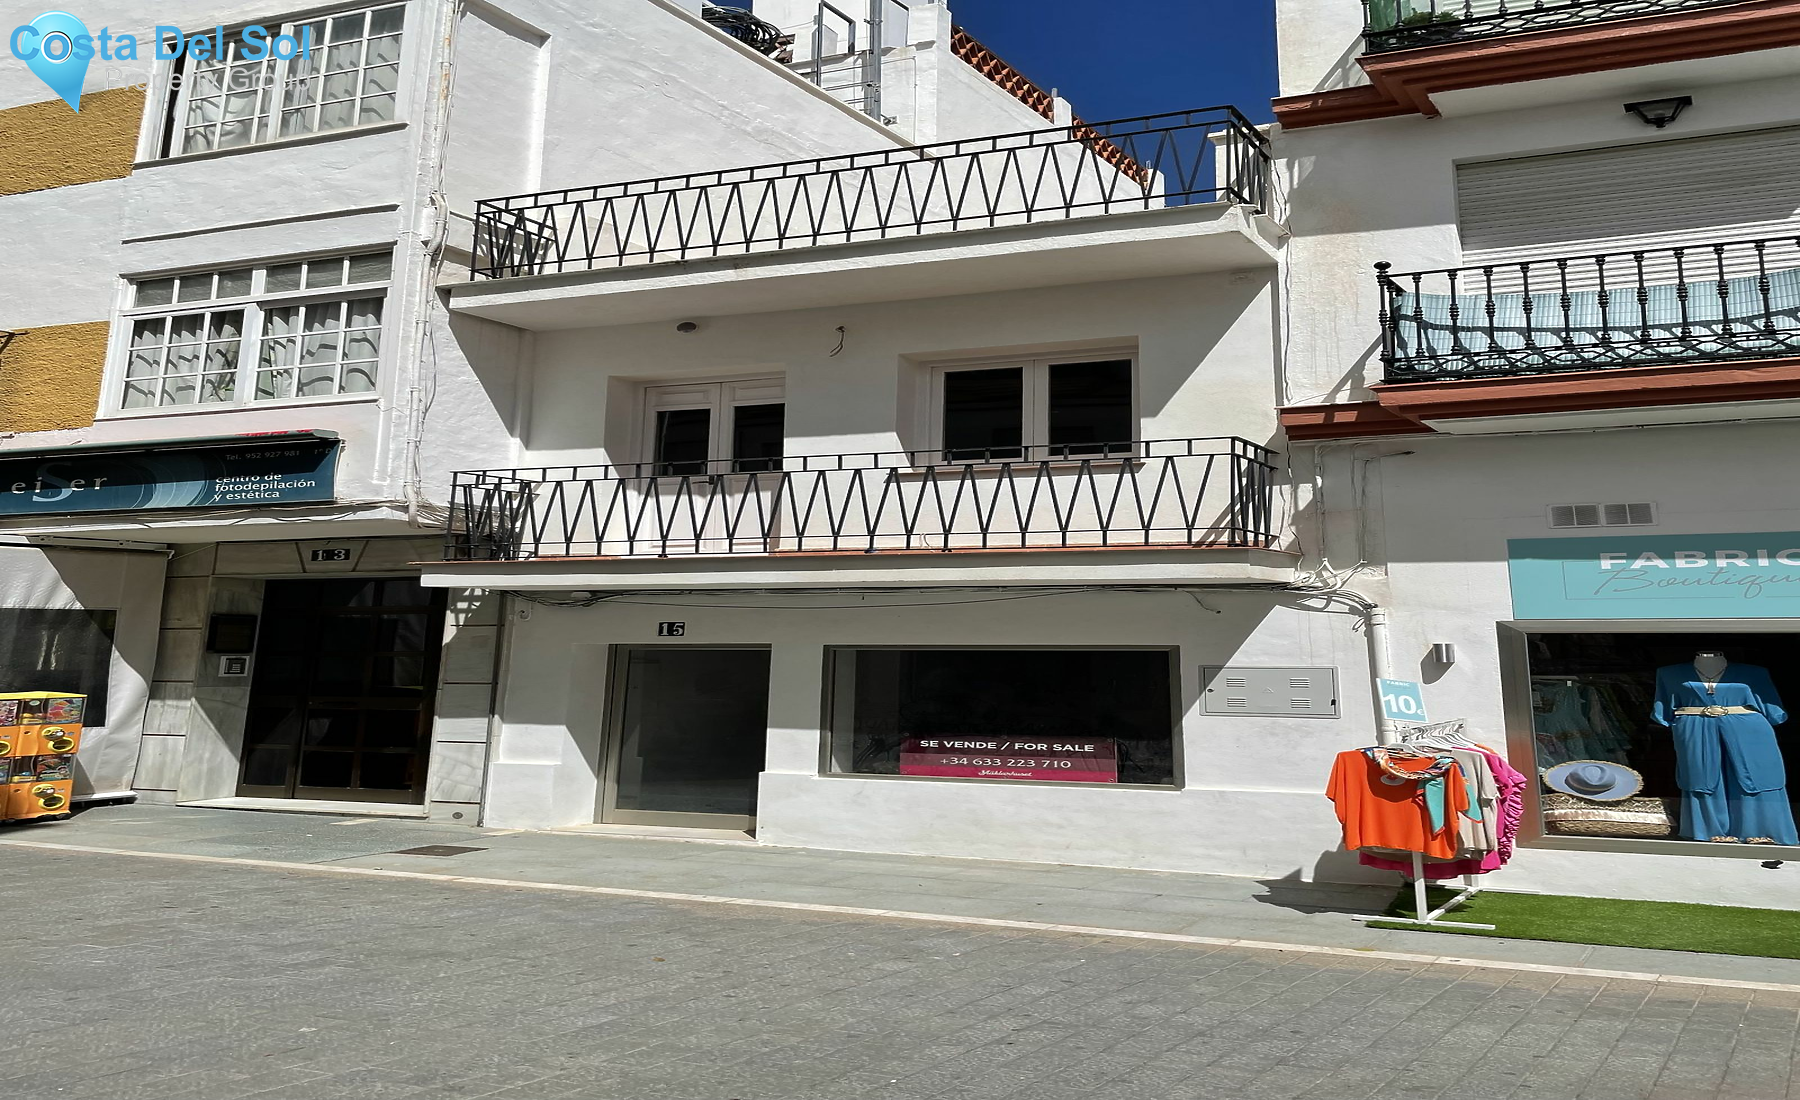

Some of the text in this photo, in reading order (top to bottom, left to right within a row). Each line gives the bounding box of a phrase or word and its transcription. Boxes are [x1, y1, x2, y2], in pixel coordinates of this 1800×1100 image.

[245, 452, 262, 460] 952
[215, 472, 282, 483] centro de
[215, 479, 316, 492] fotodepilación
[214, 490, 280, 502] y estética
[317, 549, 346, 561] 13
[1600, 548, 1800, 570] FABRIC
[1593, 566, 1800, 599] Boutiqu
[660, 623, 684, 636] 15
[920, 740, 939, 748] SE
[943, 740, 997, 750] VENDE
[1014, 742, 1050, 751] FOR
[1052, 743, 1095, 752] SALE
[940, 757, 1072, 769] +34 633 223 710
